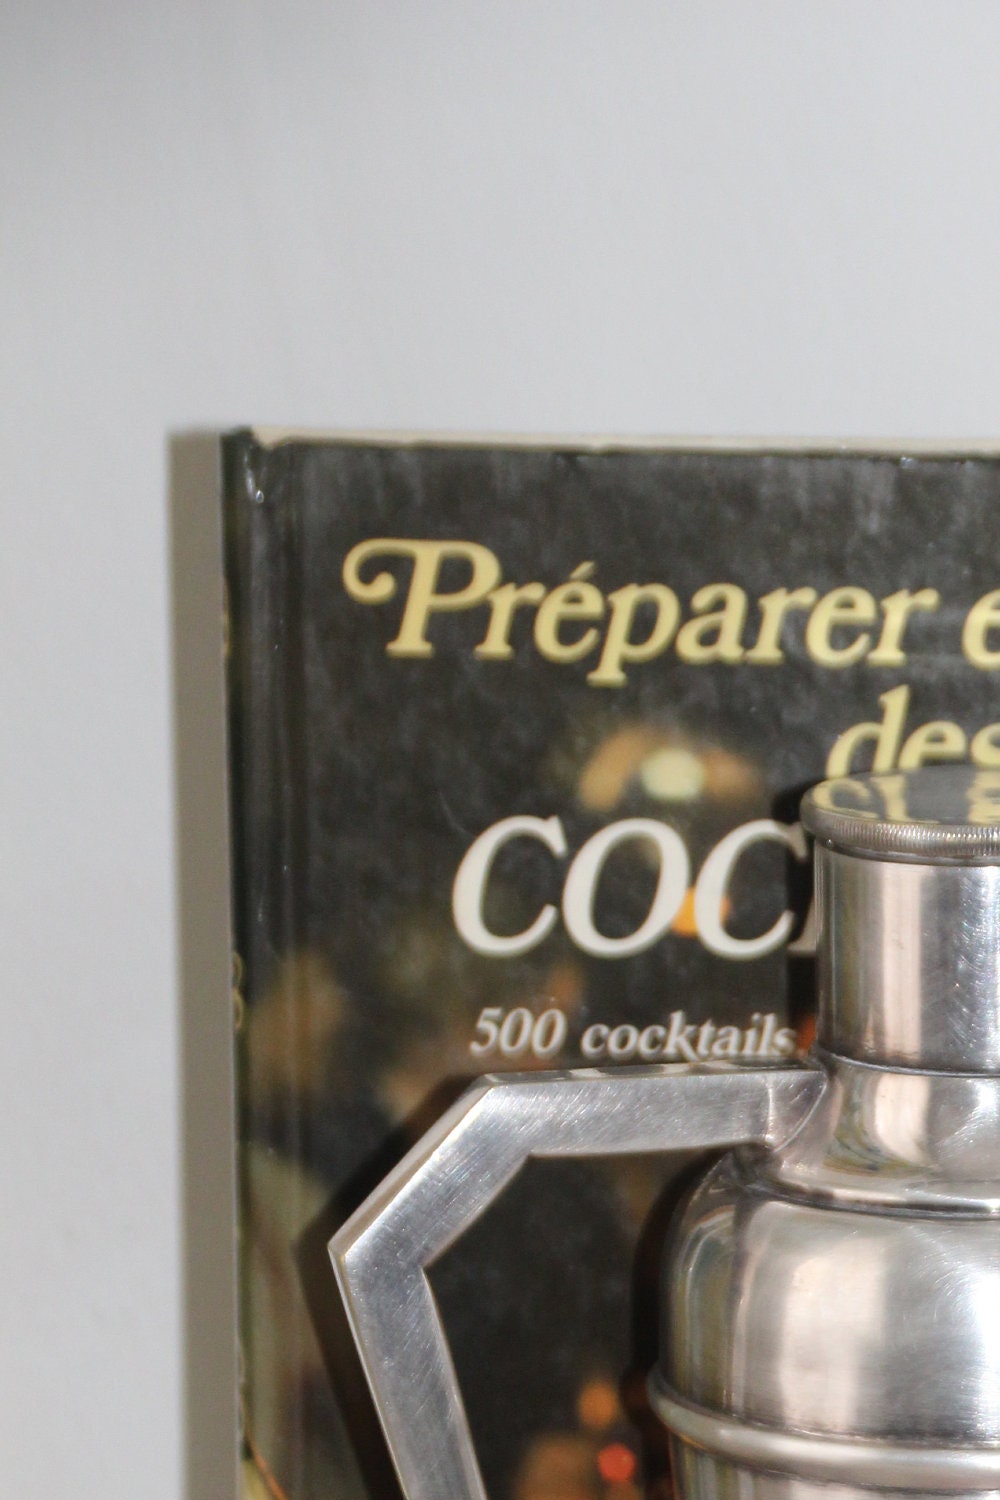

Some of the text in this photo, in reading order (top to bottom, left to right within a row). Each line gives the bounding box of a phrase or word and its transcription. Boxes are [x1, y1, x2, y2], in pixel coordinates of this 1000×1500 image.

[342, 537, 938, 688] Préparer
[470, 1007, 567, 1060] 500
[580, 1009, 797, 1062] cocktails
